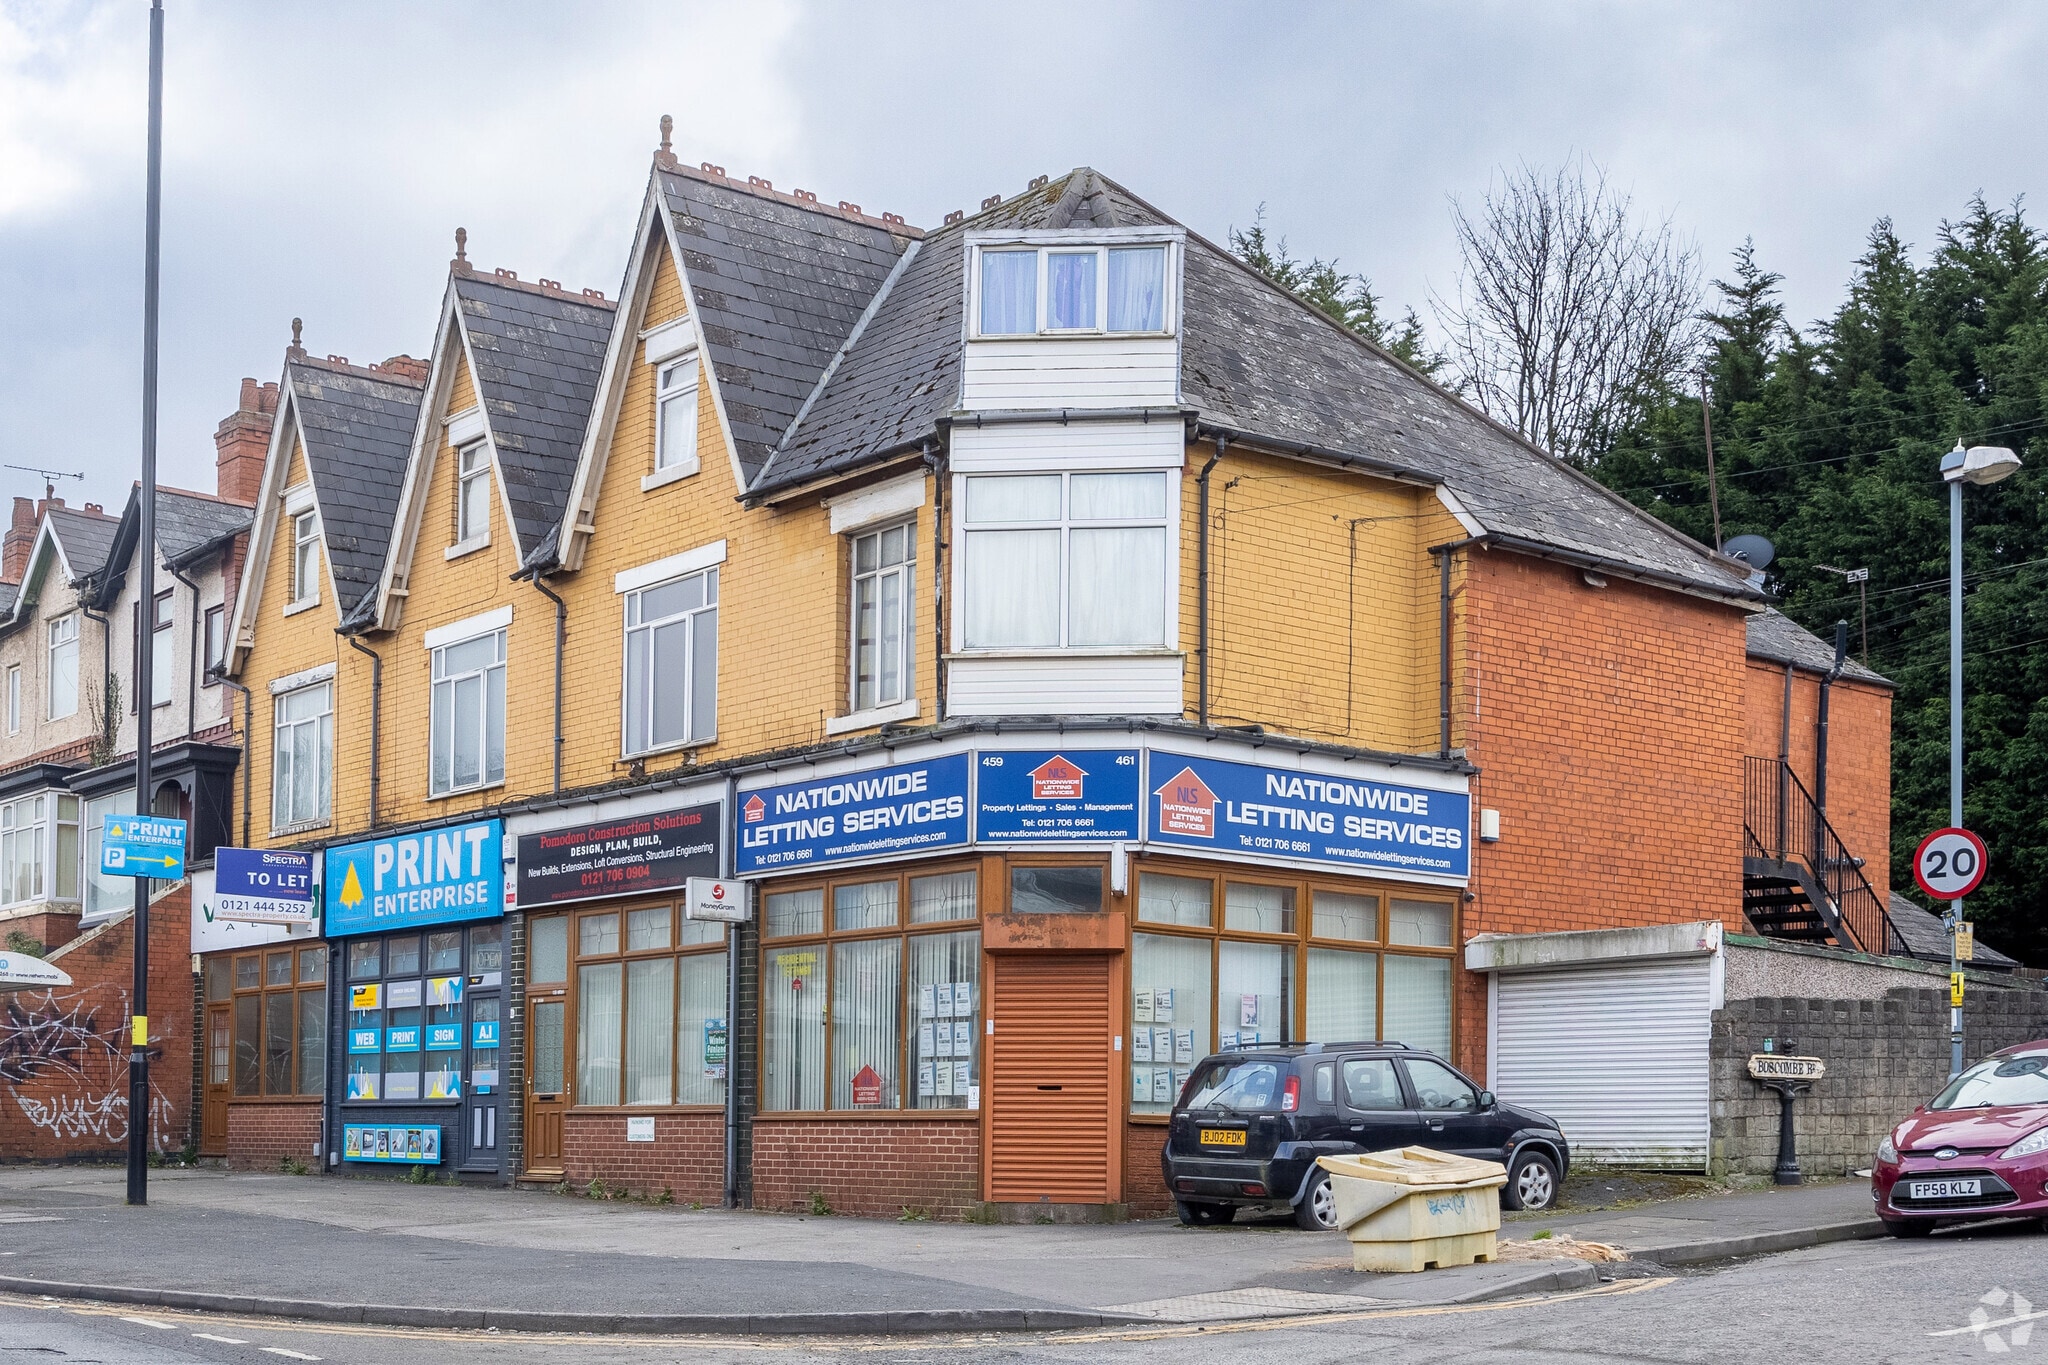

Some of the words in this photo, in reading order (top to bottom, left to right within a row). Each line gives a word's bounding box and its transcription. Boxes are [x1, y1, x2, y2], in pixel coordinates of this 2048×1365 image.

[982, 757, 1004, 767] 459
[1116, 756, 1134, 766] 461
[1048, 768, 1067, 778] NLS
[775, 770, 928, 814] NATIONWIDE
[1177, 786, 1198, 804] NLS
[1266, 774, 1428, 816] NATIONWIDE
[982, 804, 1014, 812] Property
[1016, 804, 1046, 812] Lettings
[1084, 803, 1133, 812] Management
[1164, 803, 1212, 816] NATIONWIDE
[744, 816, 834, 848] LETTING
[843, 796, 964, 834] SERVICES
[1172, 812, 1203, 822] LETTING
[128, 822, 184, 838] PRINT
[540, 834, 586, 849] Pomodoro
[588, 820, 650, 841] Construction
[653, 813, 701, 831] Solutions
[1169, 820, 1206, 831] SERVICES
[1226, 800, 1334, 835] LETTING
[1344, 816, 1462, 850] SERVICES
[128, 834, 183, 846] ENTERPRISE
[988, 830, 1128, 839] www.nationwidelettingservices.com
[570, 843, 604, 857] DESIGN,
[606, 840, 630, 852] PLAN,
[633, 835, 662, 846] BUILD,
[824, 831, 946, 856] www.nationwidelettingservices.com
[1240, 835, 1253, 847] Tel:
[1255, 837, 1272, 849] 0121
[1274, 838, 1289, 850] 706
[1291, 840, 1310, 853] 6661
[109, 850, 120, 864] P
[374, 825, 490, 892] PRINT
[528, 868, 541, 878] New
[541, 865, 560, 876] Builds,
[561, 861, 593, 874] Extensions,
[594, 858, 606, 868] Loft
[606, 854, 644, 867] Conversions,
[646, 848, 675, 861] Structural
[676, 842, 714, 858] Engineering
[754, 855, 766, 866] Tel:
[767, 852, 781, 864] 0121
[782, 851, 795, 862] 706
[796, 848, 812, 860] 6661
[1325, 846, 1450, 869] www.nationwidelettingservices.com
[1926, 848, 1976, 878] 20
[247, 872, 270, 885] TO
[278, 874, 308, 887] LET
[581, 871, 603, 886] 0121
[607, 868, 623, 882] 706
[626, 865, 650, 879] 0904
[374, 880, 488, 917] ENTERPRISE
[221, 900, 249, 910] 0121
[254, 902, 275, 911] 444
[278, 903, 306, 913] 5252
[478, 952, 500, 967] OPEN
[356, 1032, 375, 1045] WEB
[392, 1031, 416, 1044] PRINT
[434, 1029, 454, 1041] SIGN
[1758, 1061, 1803, 1075] BOSCOMBE
[1204, 1132, 1225, 1142] BJ02
[1226, 1132, 1242, 1143] FDK
[1915, 1184, 1947, 1196] FP58
[1950, 1182, 1975, 1194] KLZ
